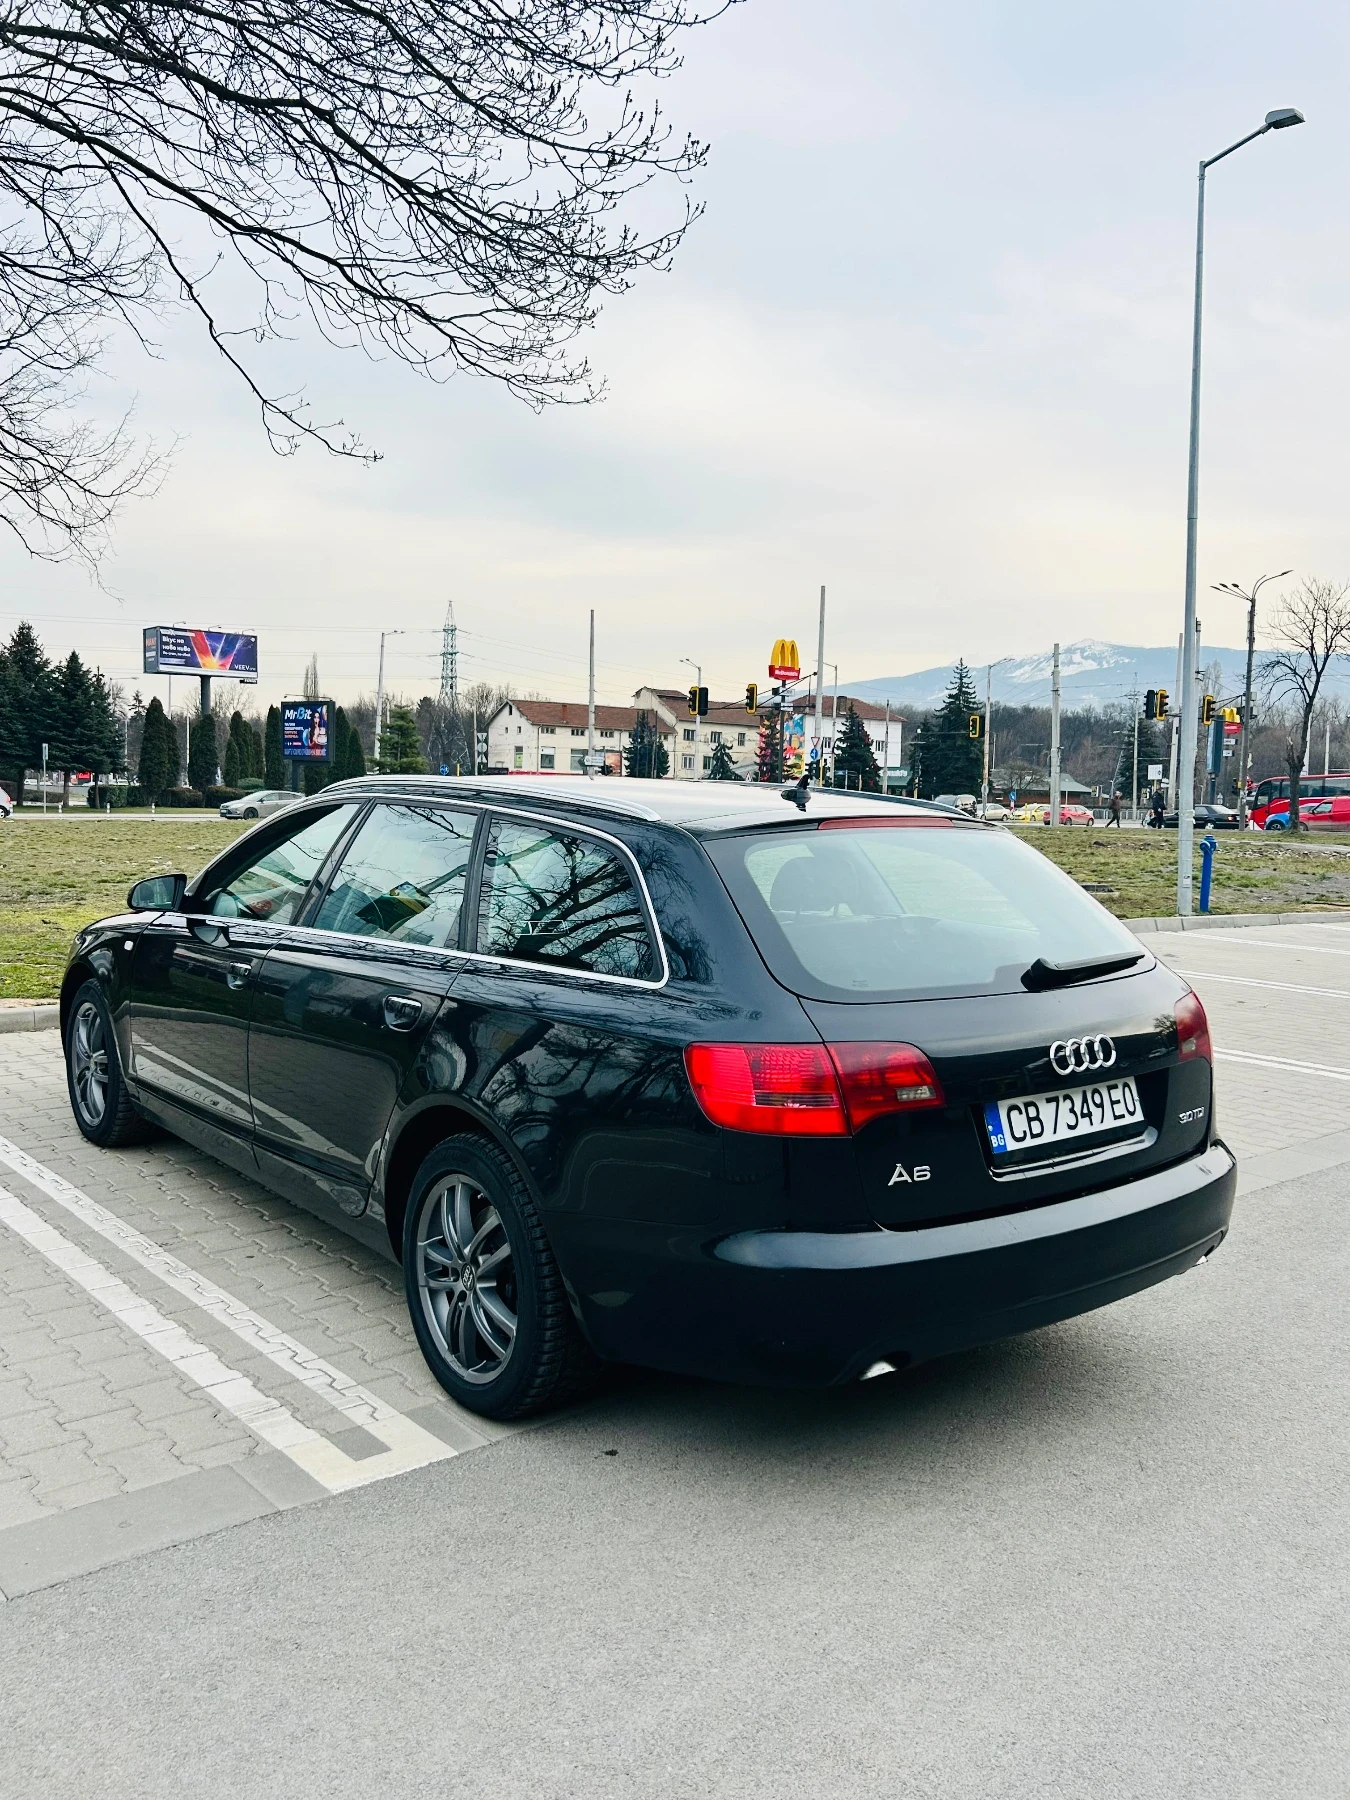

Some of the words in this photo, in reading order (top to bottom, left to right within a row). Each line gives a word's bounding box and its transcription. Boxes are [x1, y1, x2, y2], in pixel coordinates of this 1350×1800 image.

[284, 706, 312, 720] MrBit
[990, 1134, 1004, 1148] BG
[887, 1163, 931, 1186] A6
